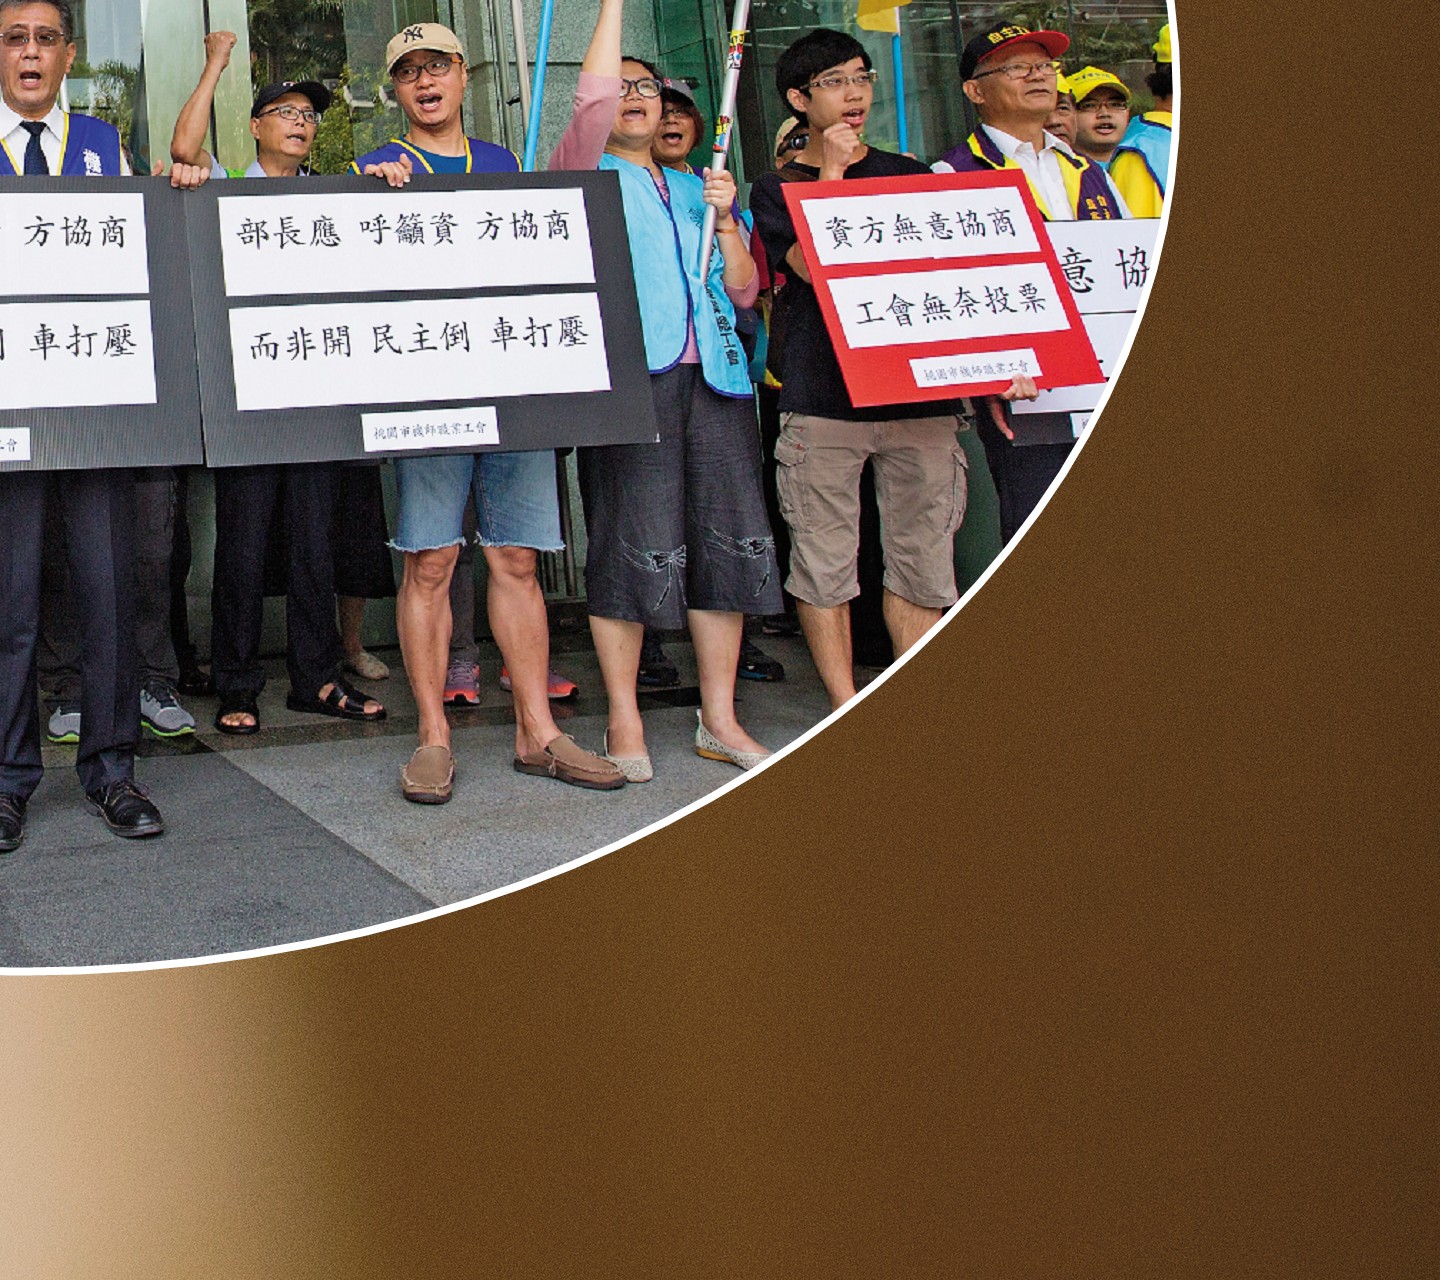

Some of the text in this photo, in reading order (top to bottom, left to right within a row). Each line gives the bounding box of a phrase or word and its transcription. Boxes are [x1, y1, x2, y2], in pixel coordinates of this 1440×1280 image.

[82, 148, 104, 177] 機
[237, 210, 568, 249] 部長應呼籲資方協商
[825, 208, 1017, 250] 資方無意協商
[857, 283, 1047, 327] 工會無奈投票
[251, 316, 587, 360] 而非開民主倒車打壓
